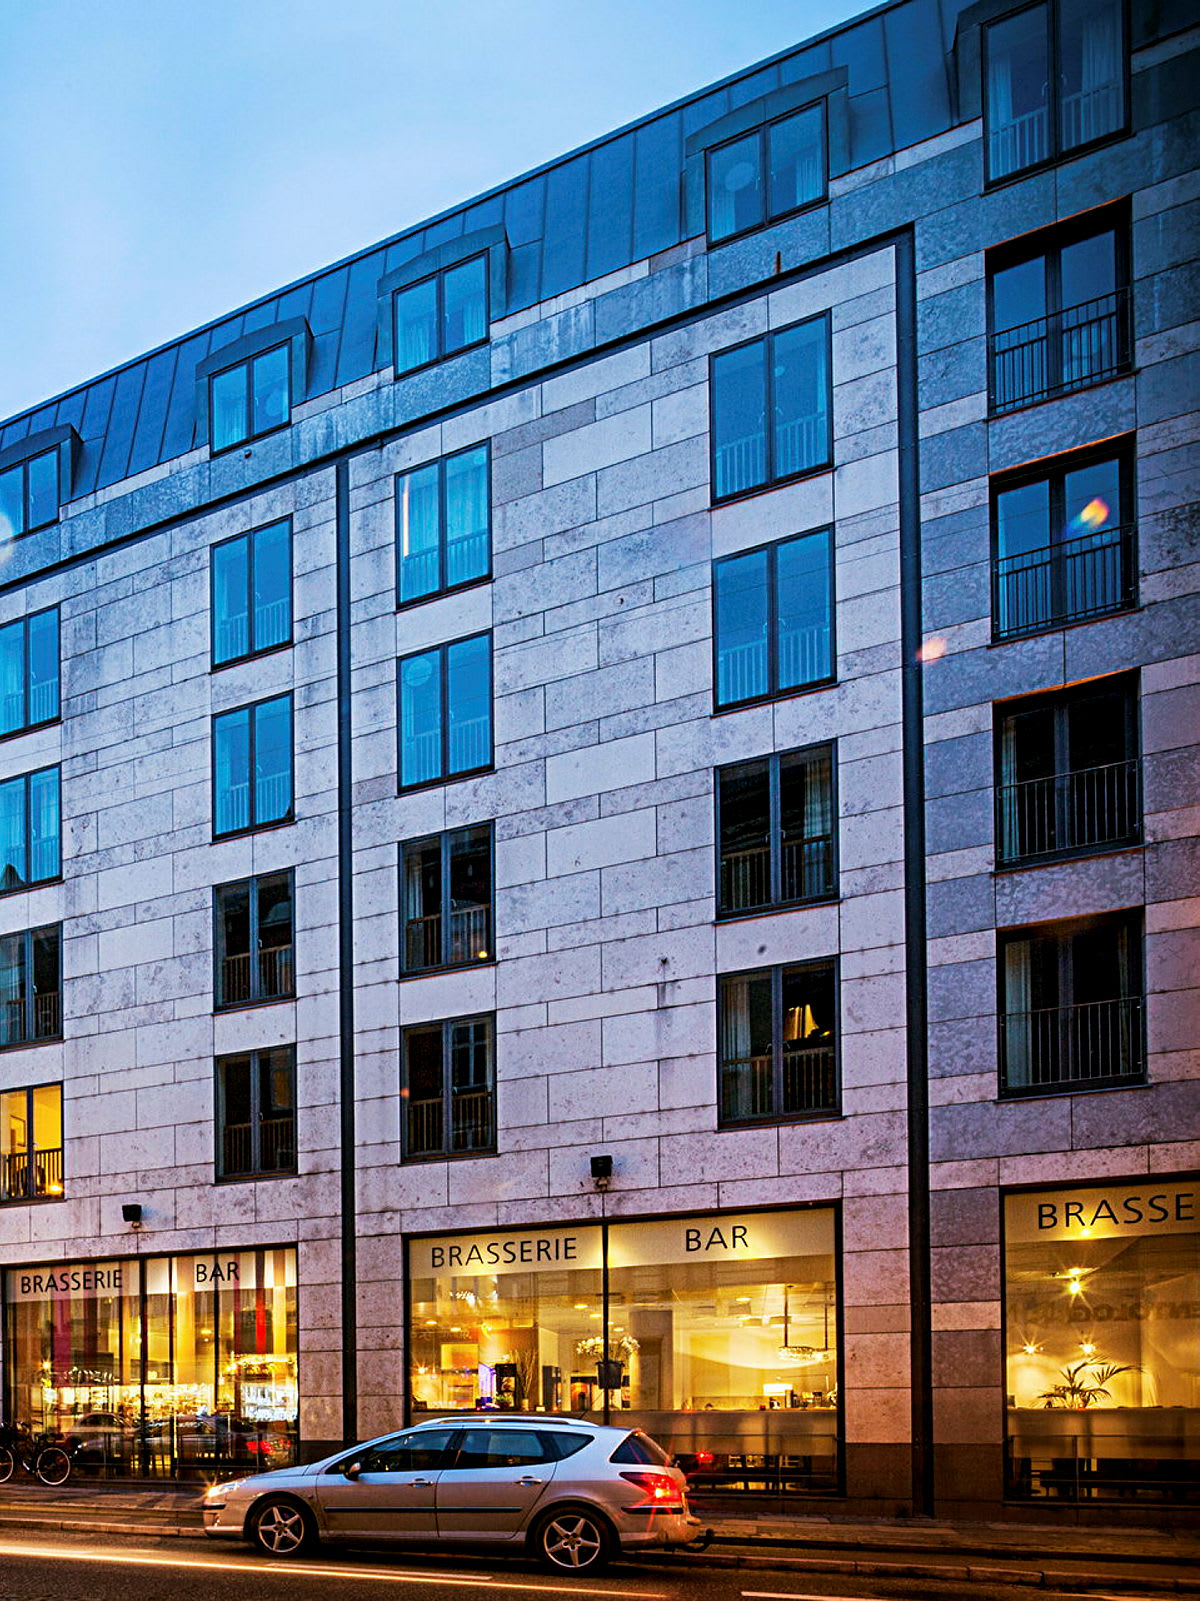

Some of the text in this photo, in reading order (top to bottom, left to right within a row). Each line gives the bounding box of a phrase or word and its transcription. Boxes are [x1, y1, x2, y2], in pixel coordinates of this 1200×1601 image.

[430, 1225, 750, 1268] BRASSERIE BAR
[20, 1261, 240, 1294] BRASSERIE BAR
